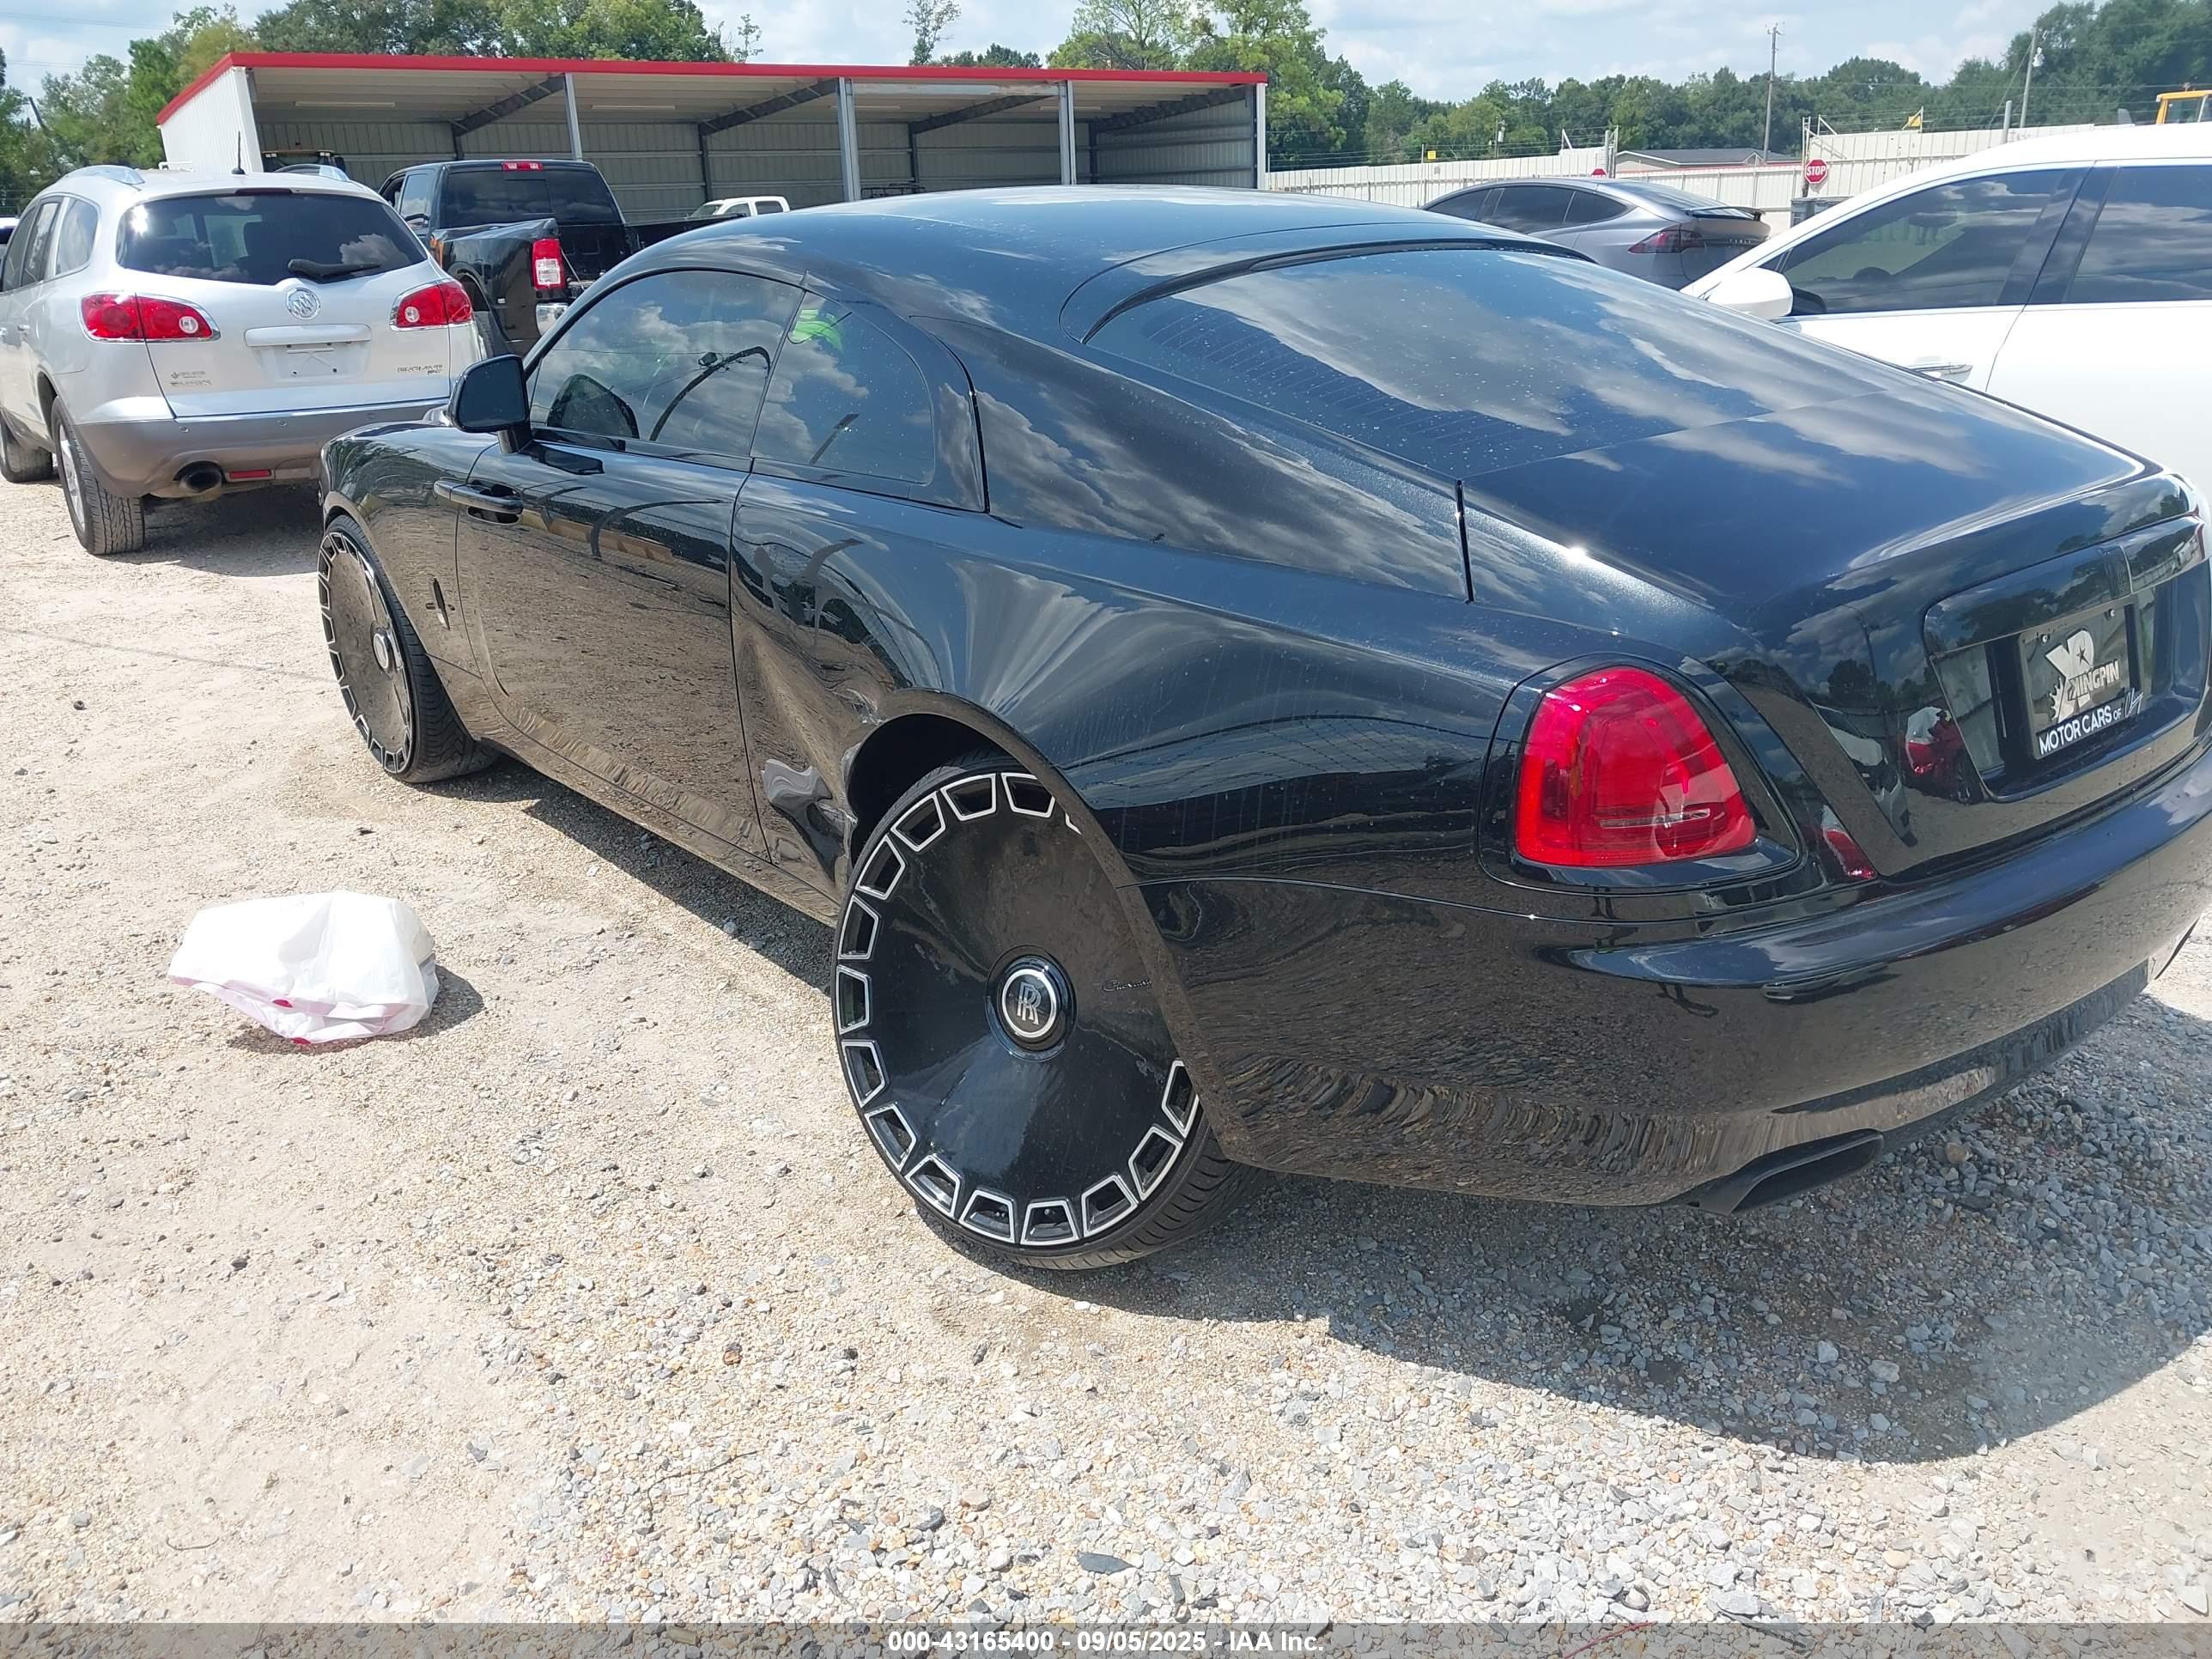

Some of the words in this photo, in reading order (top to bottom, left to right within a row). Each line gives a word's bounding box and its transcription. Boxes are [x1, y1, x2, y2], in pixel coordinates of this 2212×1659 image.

[1806, 165, 1826, 176] STOP
[2069, 659, 2119, 698] KINGPIN
[2039, 719, 2081, 756] MOTOR
[2081, 705, 2112, 733] CARS
[2112, 707, 2122, 720] OF
